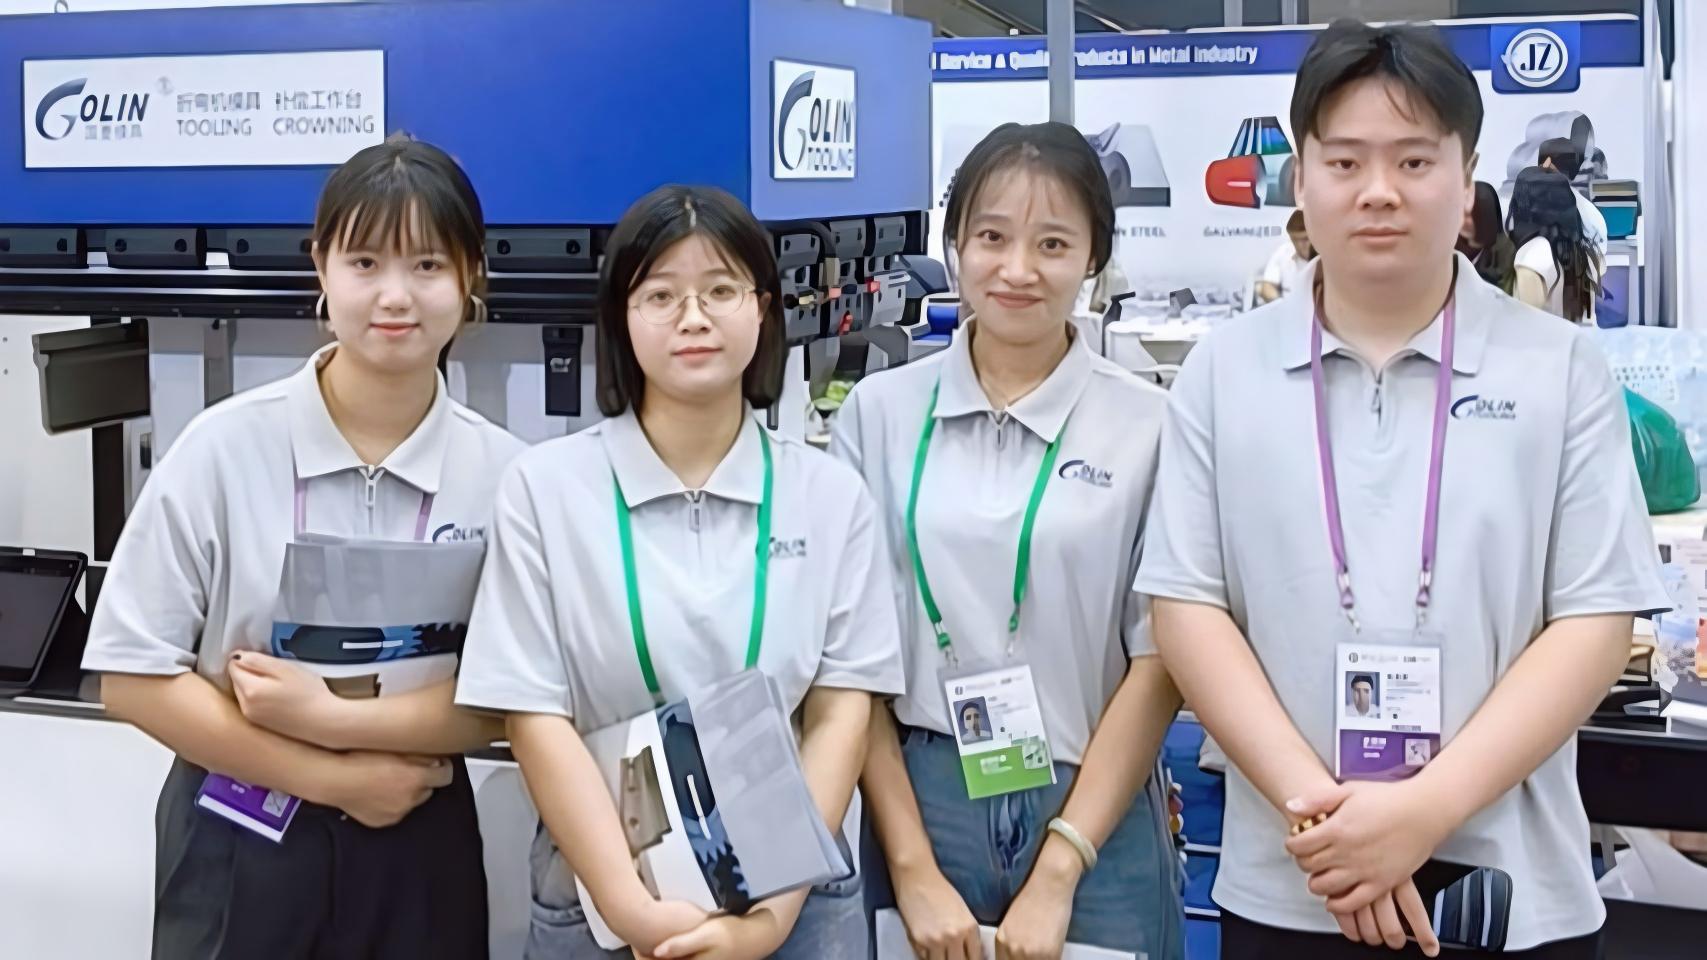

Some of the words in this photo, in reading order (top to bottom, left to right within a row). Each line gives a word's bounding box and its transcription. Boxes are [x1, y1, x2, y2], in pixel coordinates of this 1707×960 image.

[1009, 50, 1050, 70] Quali
[1075, 48, 1127, 66] roducts
[1194, 45, 1257, 64] Industry
[1520, 43, 1552, 70] JZ
[35, 77, 150, 140] GOLIN
[779, 70, 854, 171] GOLIN
[176, 118, 252, 136] TOOLING
[272, 115, 375, 136] CROWNING
